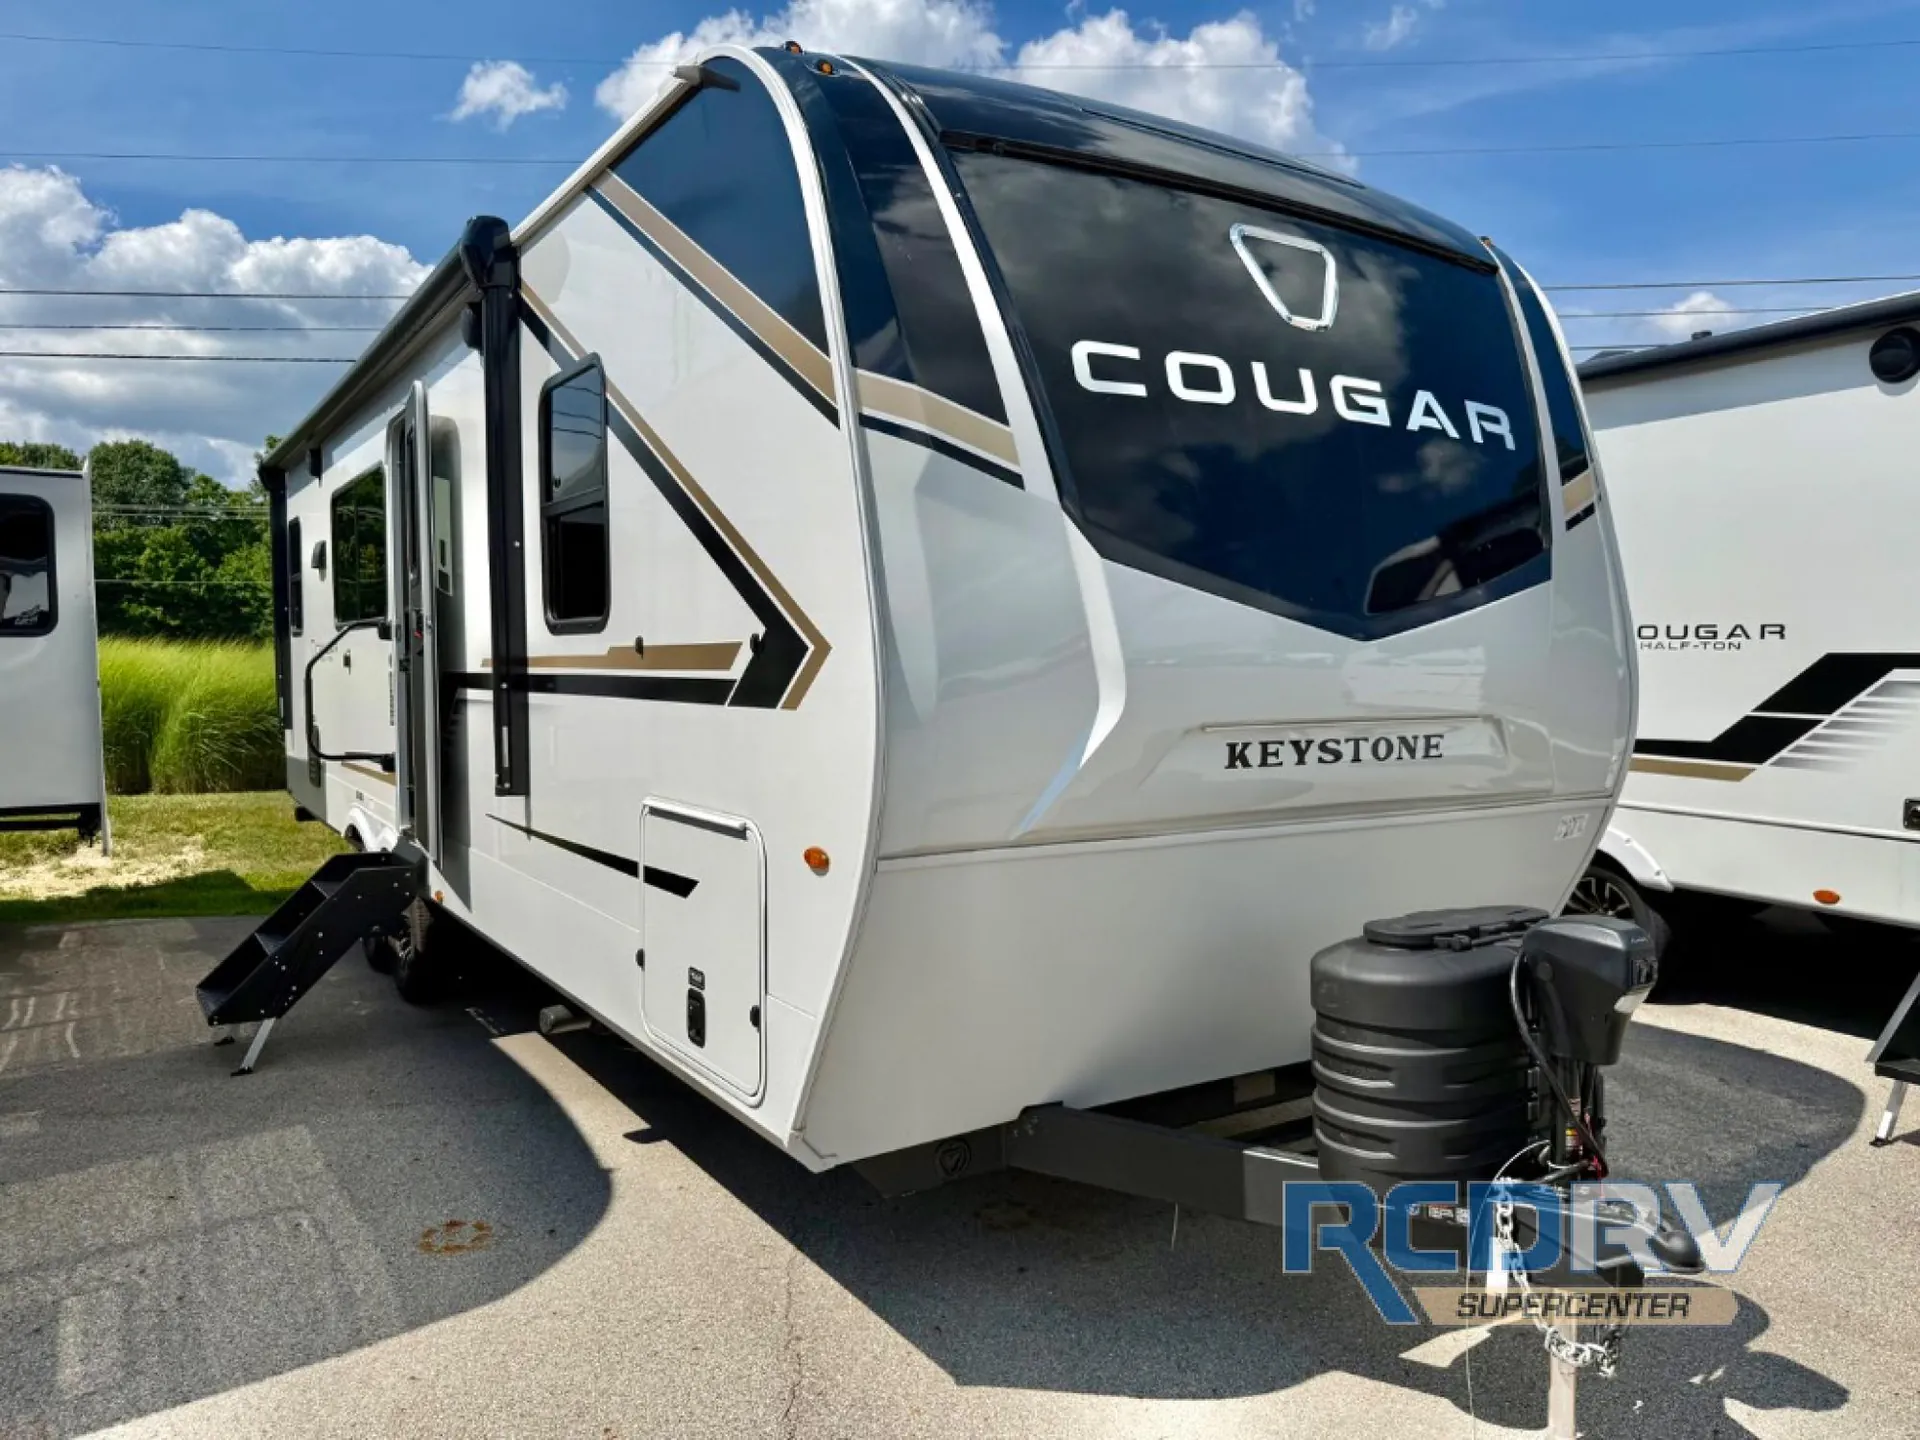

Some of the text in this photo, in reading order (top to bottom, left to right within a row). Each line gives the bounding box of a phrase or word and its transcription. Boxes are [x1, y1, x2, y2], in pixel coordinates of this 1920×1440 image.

[1070, 340, 1516, 451] COUGAR
[1637, 623, 1786, 640] OUGAR
[1640, 640, 1742, 651] HALF-TON
[1224, 734, 1444, 769] KEYSTONE
